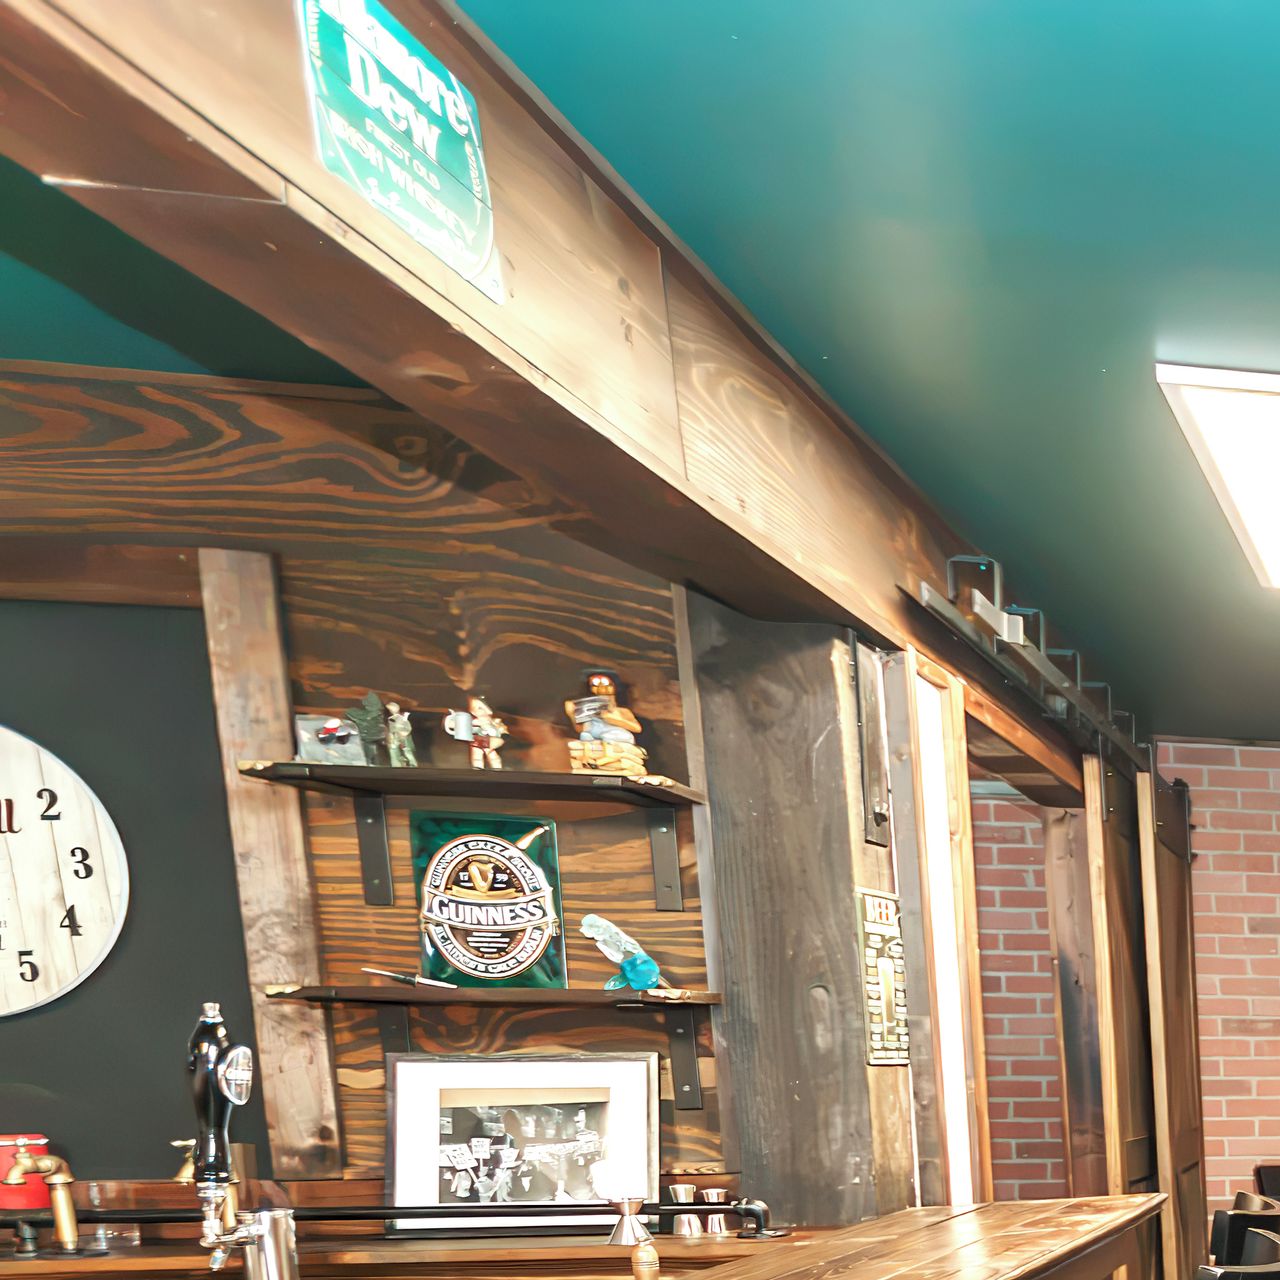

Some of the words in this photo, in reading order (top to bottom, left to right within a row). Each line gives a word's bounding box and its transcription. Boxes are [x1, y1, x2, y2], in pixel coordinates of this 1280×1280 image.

[343, 29, 441, 161] Dew
[412, 156, 441, 193] OLD
[36, 788, 62, 821] 2
[70, 847, 93, 880] 3
[59, 904, 83, 936] 4
[432, 895, 544, 926] GUINNESS
[17, 950, 40, 982] 5
